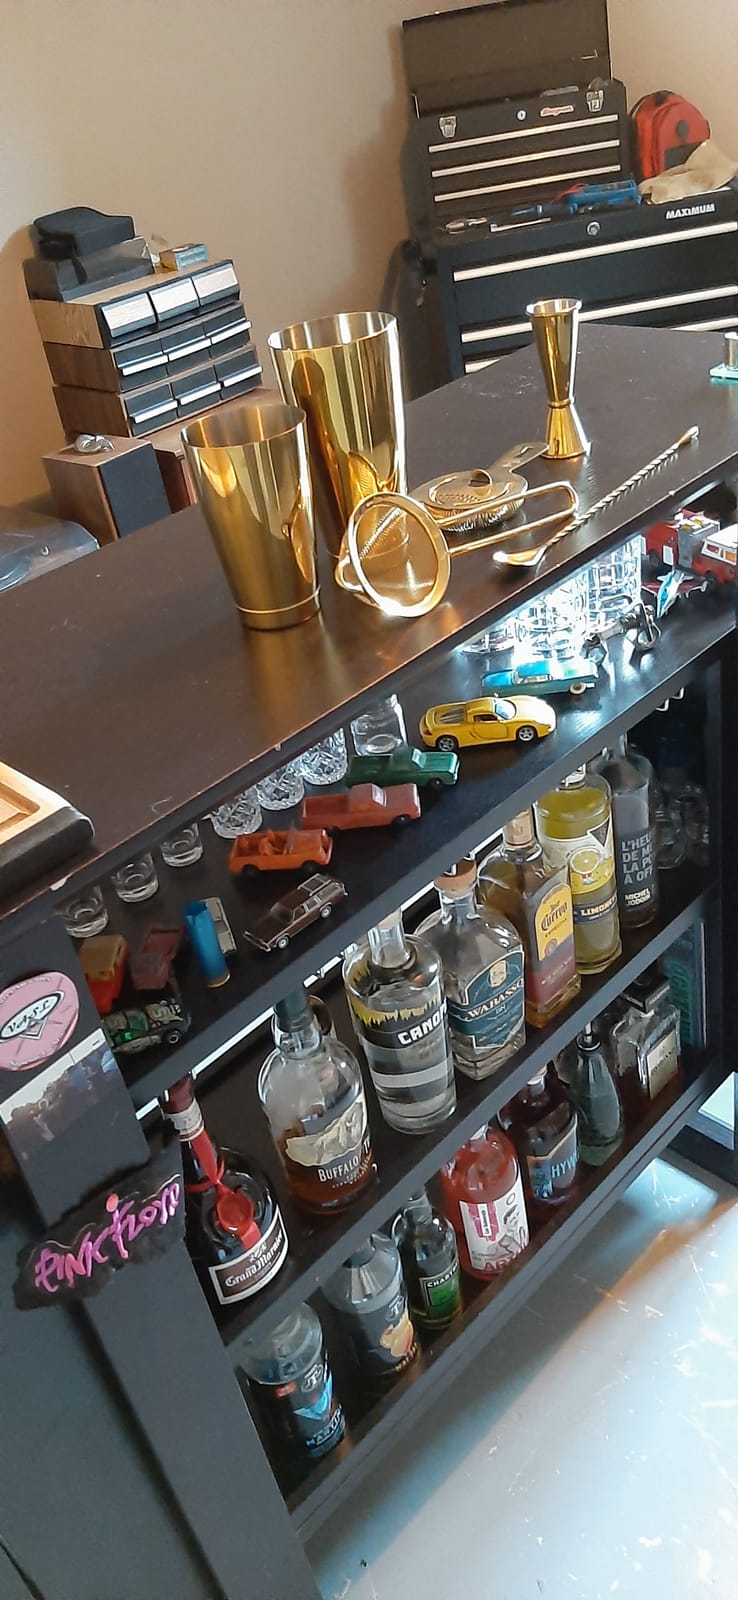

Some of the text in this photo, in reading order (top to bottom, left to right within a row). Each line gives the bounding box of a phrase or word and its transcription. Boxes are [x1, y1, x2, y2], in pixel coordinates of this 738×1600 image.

[666, 203, 715, 219] MAXIMUM
[622, 852, 639, 862] DE
[623, 861, 639, 874] LA
